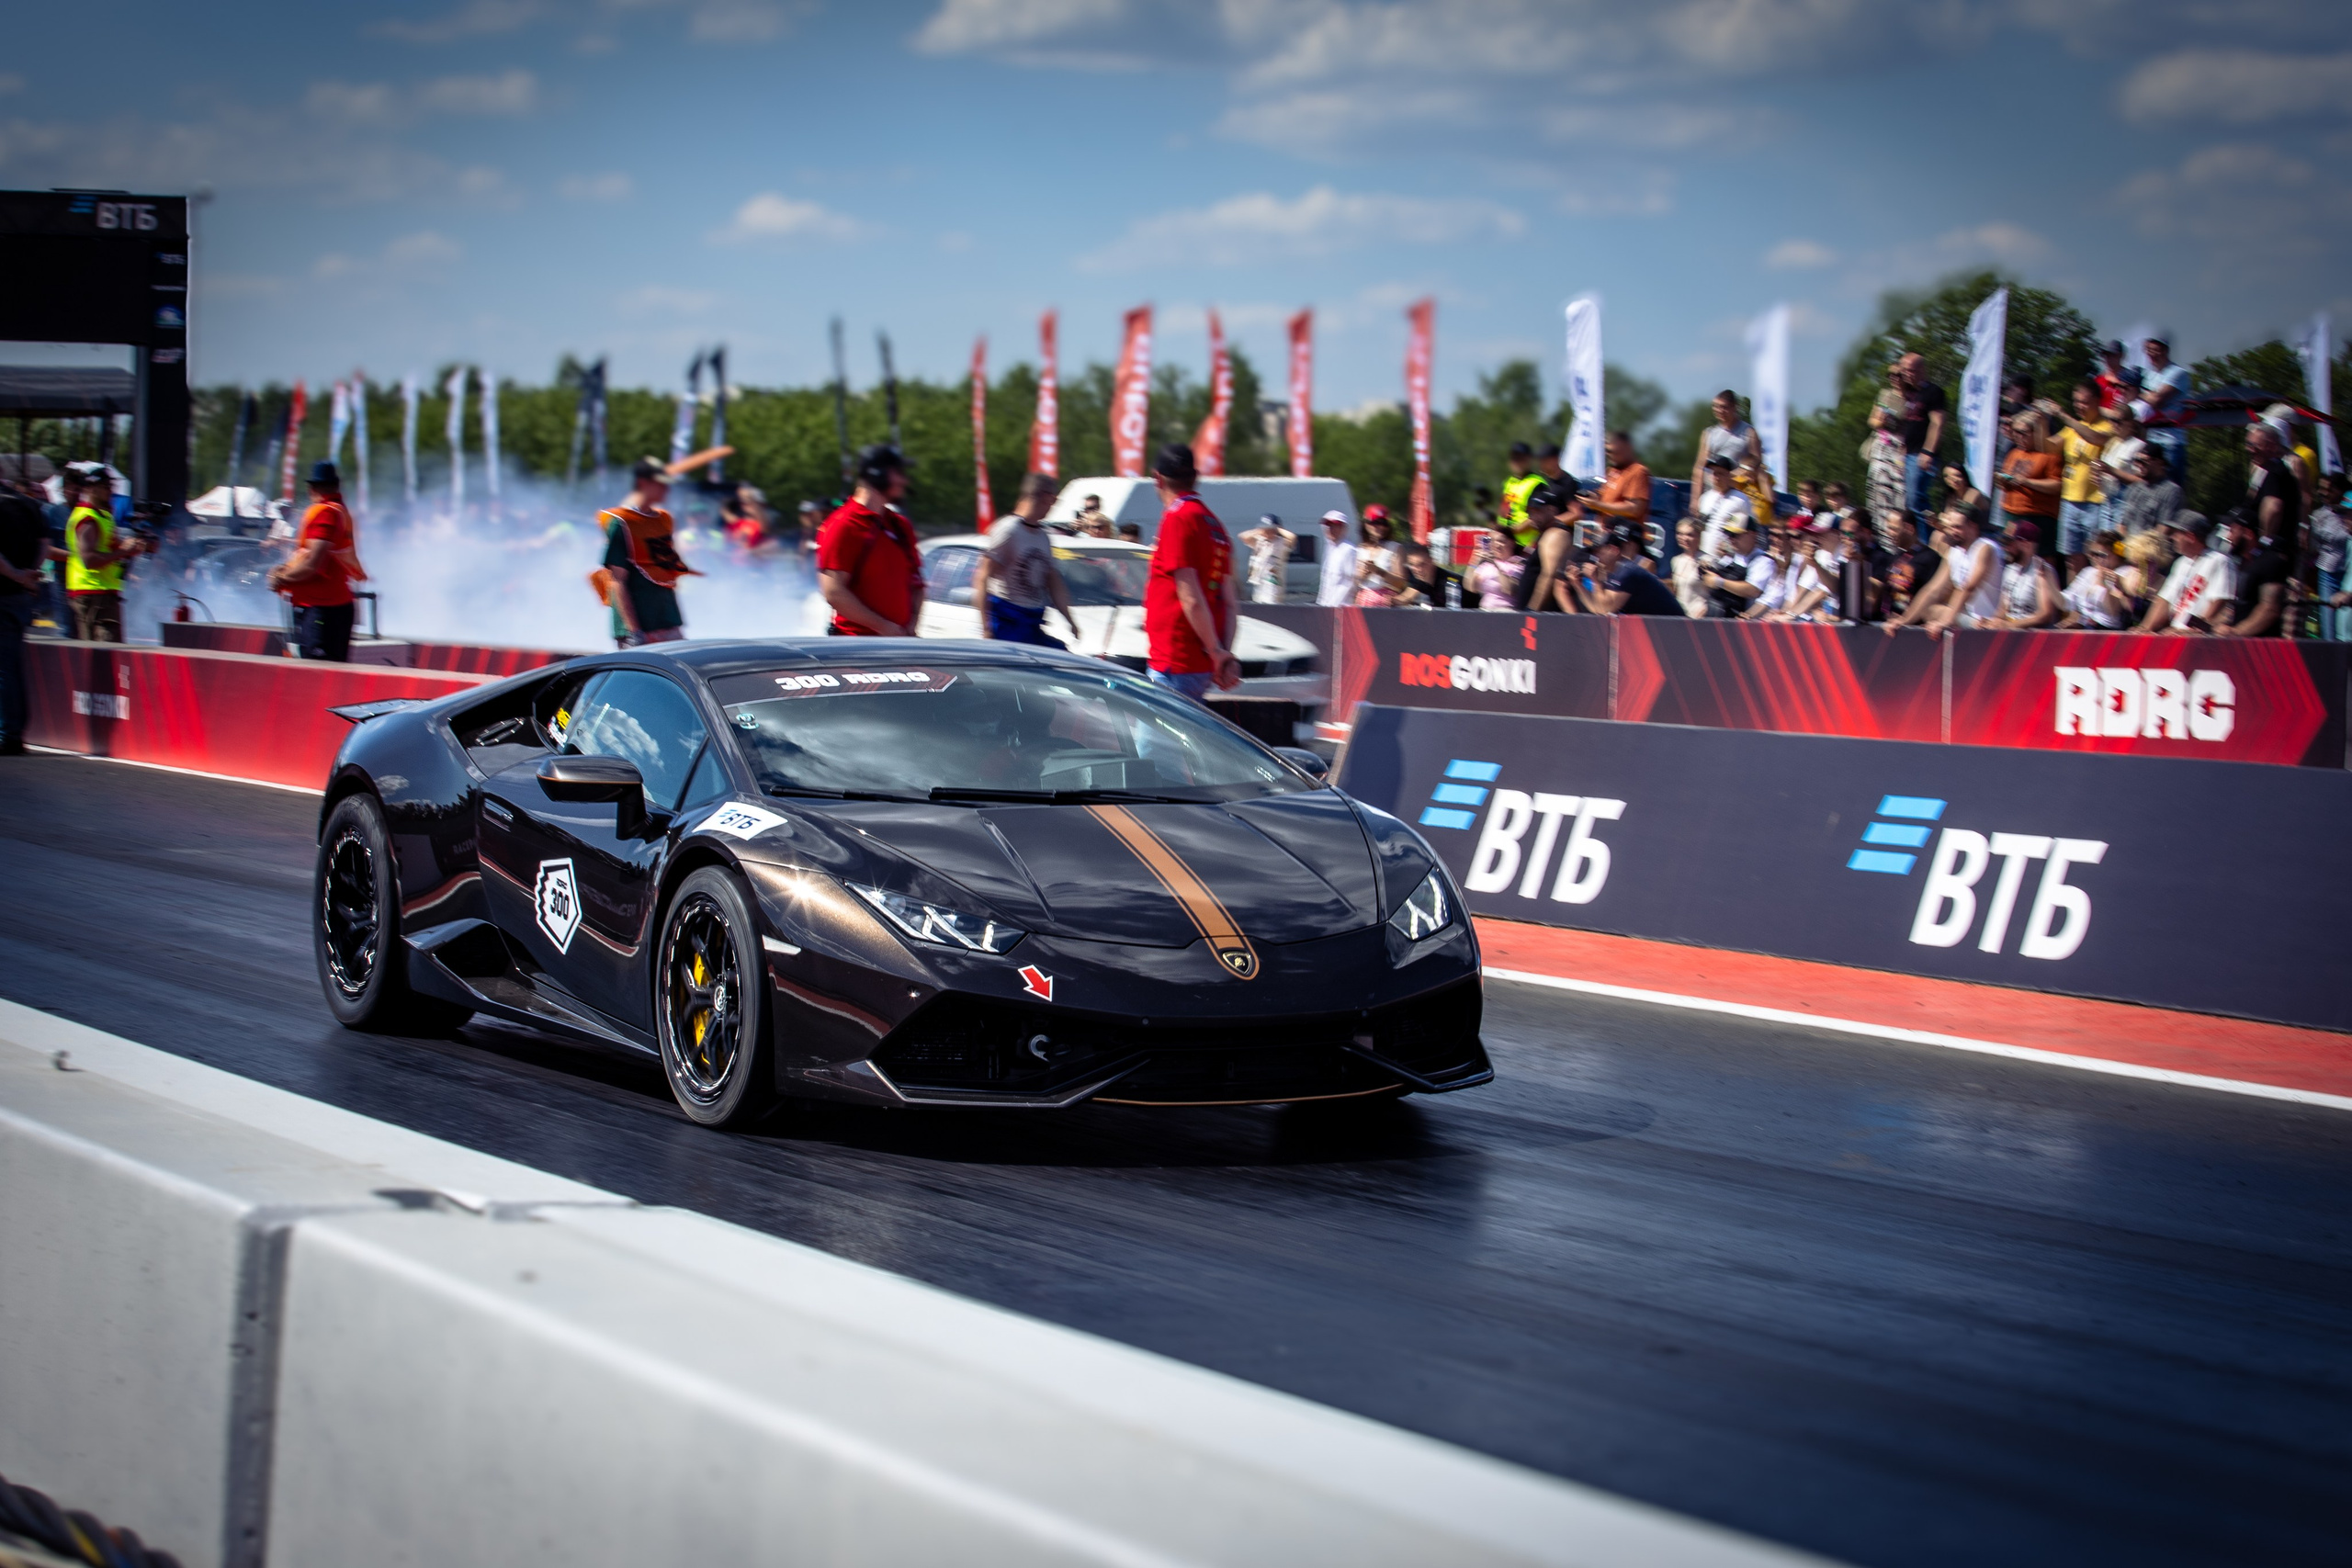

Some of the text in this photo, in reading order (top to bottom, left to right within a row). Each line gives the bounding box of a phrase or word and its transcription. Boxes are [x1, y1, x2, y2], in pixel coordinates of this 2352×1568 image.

[96, 201, 158, 230] ВТБ
[775, 674, 840, 690] 300
[1399, 652, 1537, 694] ROSGONKI
[2053, 666, 2236, 742] RDRC
[720, 813, 762, 829] ВТБ
[1464, 788, 1627, 905] ВТБ
[550, 887, 570, 921] 300
[1908, 828, 2109, 961] ВТБ
